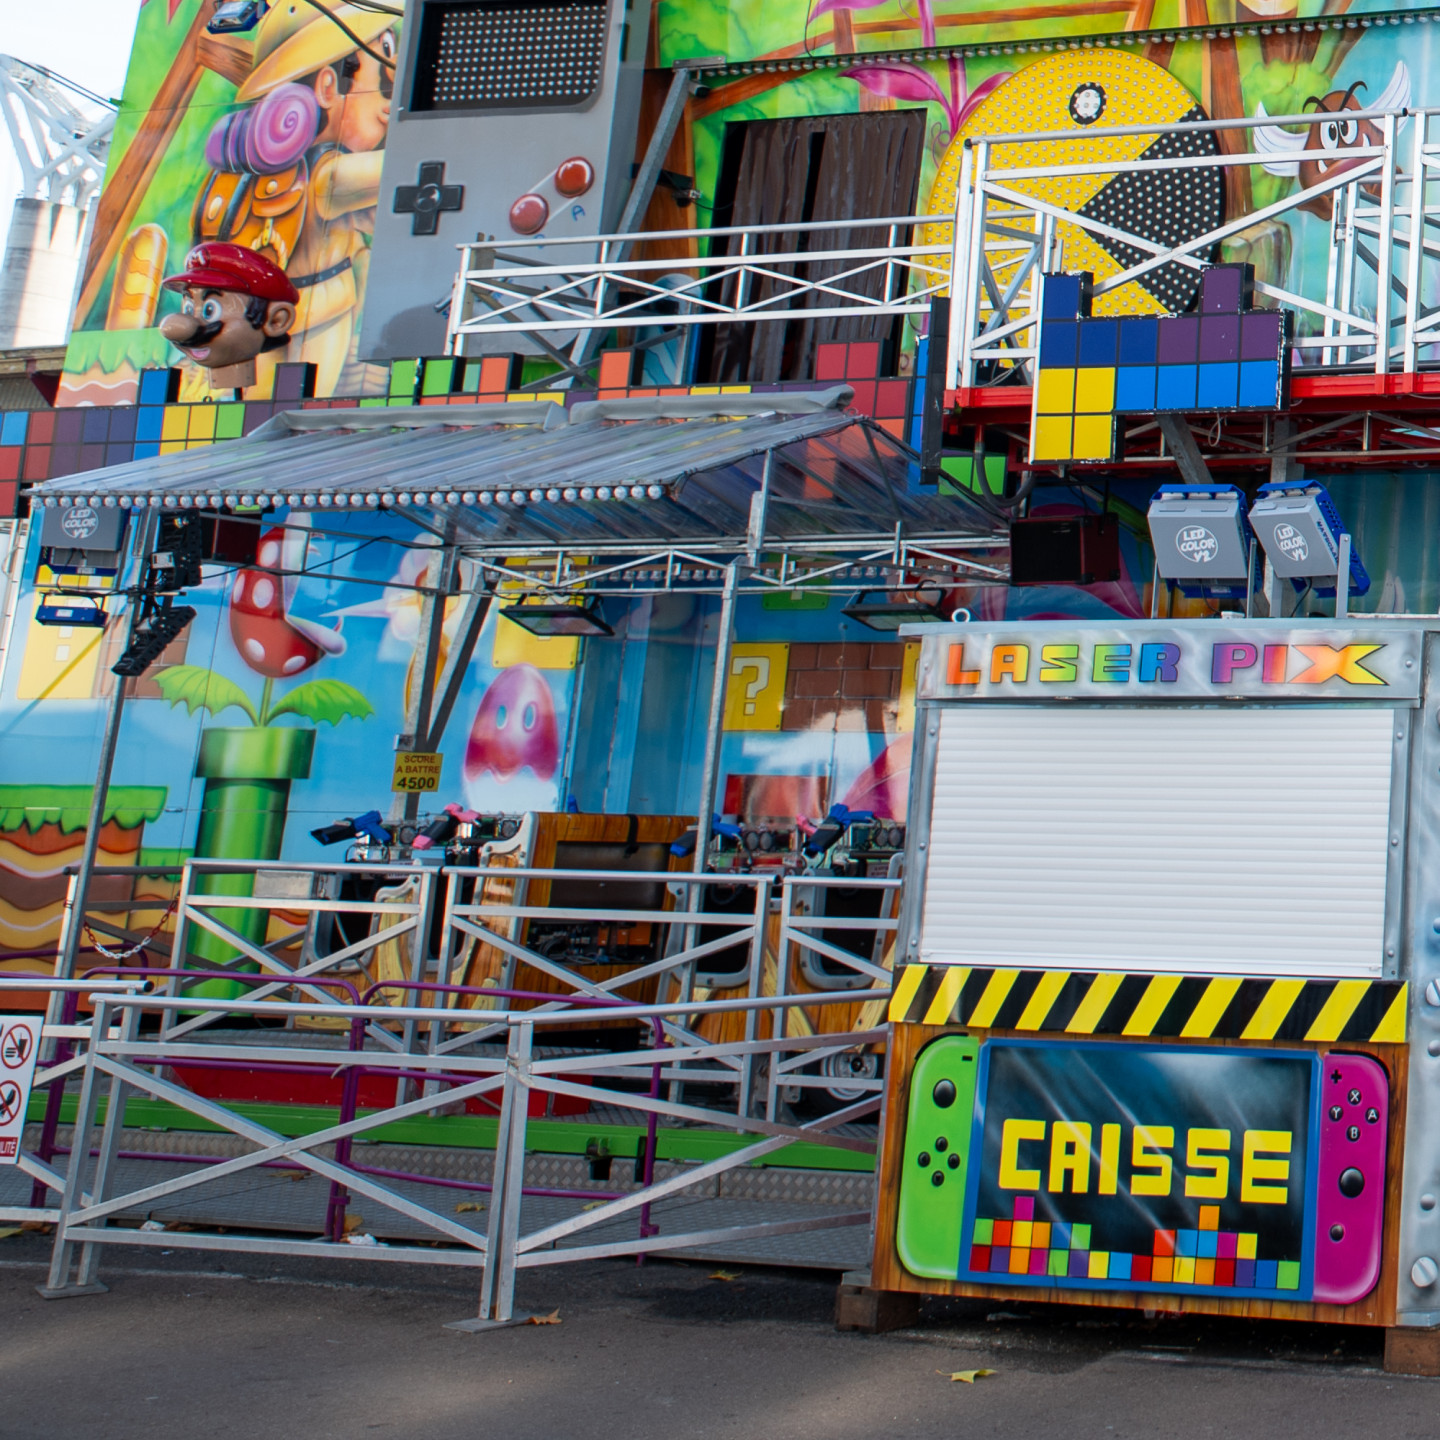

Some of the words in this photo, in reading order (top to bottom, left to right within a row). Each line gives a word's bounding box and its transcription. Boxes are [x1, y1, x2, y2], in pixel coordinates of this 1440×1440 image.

[1183, 527, 1205, 540] LED
[1277, 527, 1293, 539] LED
[1180, 538, 1216, 552] COLOR
[1280, 536, 1305, 551] COLOR
[945, 642, 1182, 686] LASER
[1210, 642, 1391, 686] PIX
[404, 755, 436, 763] SCORE
[405, 766, 440, 774] BATTRE
[396, 777, 435, 789] 4500
[1350, 1089, 1360, 1102] X
[1332, 1106, 1341, 1119] Y
[1367, 1108, 1377, 1120] A
[1351, 1126, 1359, 1139] B
[997, 1116, 1294, 1206] CAISSE
